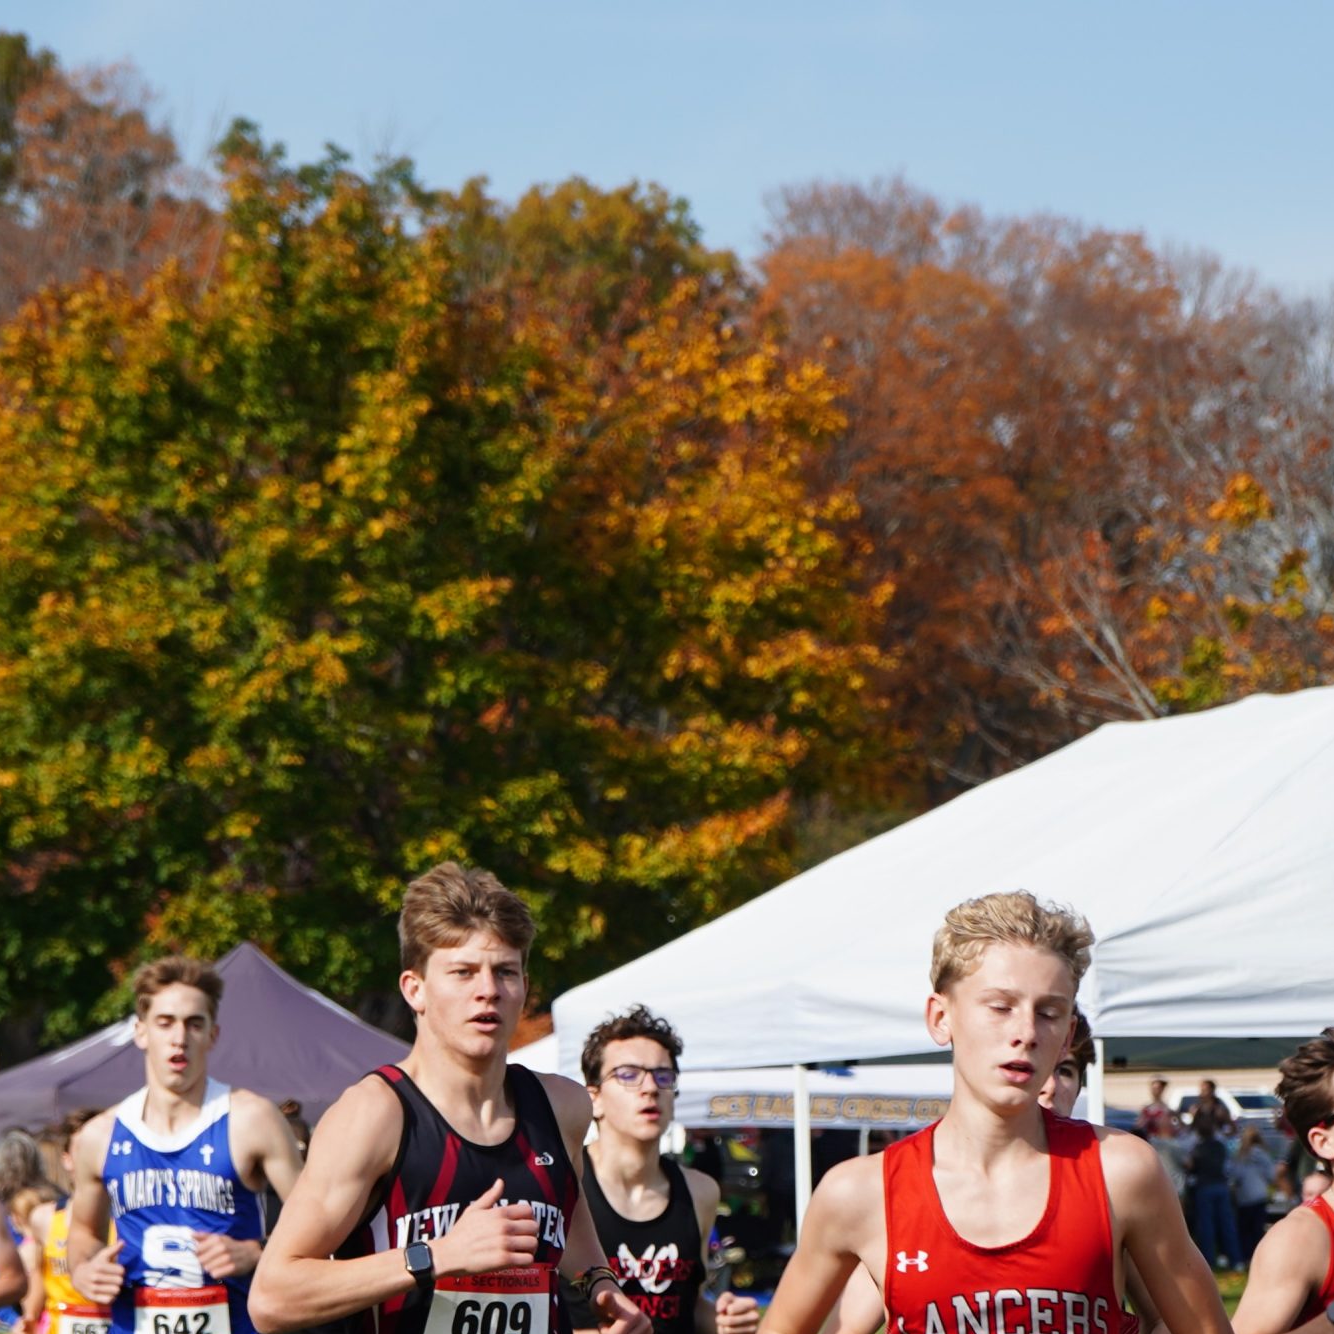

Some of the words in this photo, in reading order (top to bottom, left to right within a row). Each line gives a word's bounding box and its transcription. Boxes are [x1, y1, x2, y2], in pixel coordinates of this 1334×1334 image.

[123, 1167, 177, 1212] MARY'S
[176, 1168, 236, 1215] SPRINGS
[396, 1203, 460, 1250] NEW
[471, 1275, 541, 1289] SECTIONALS
